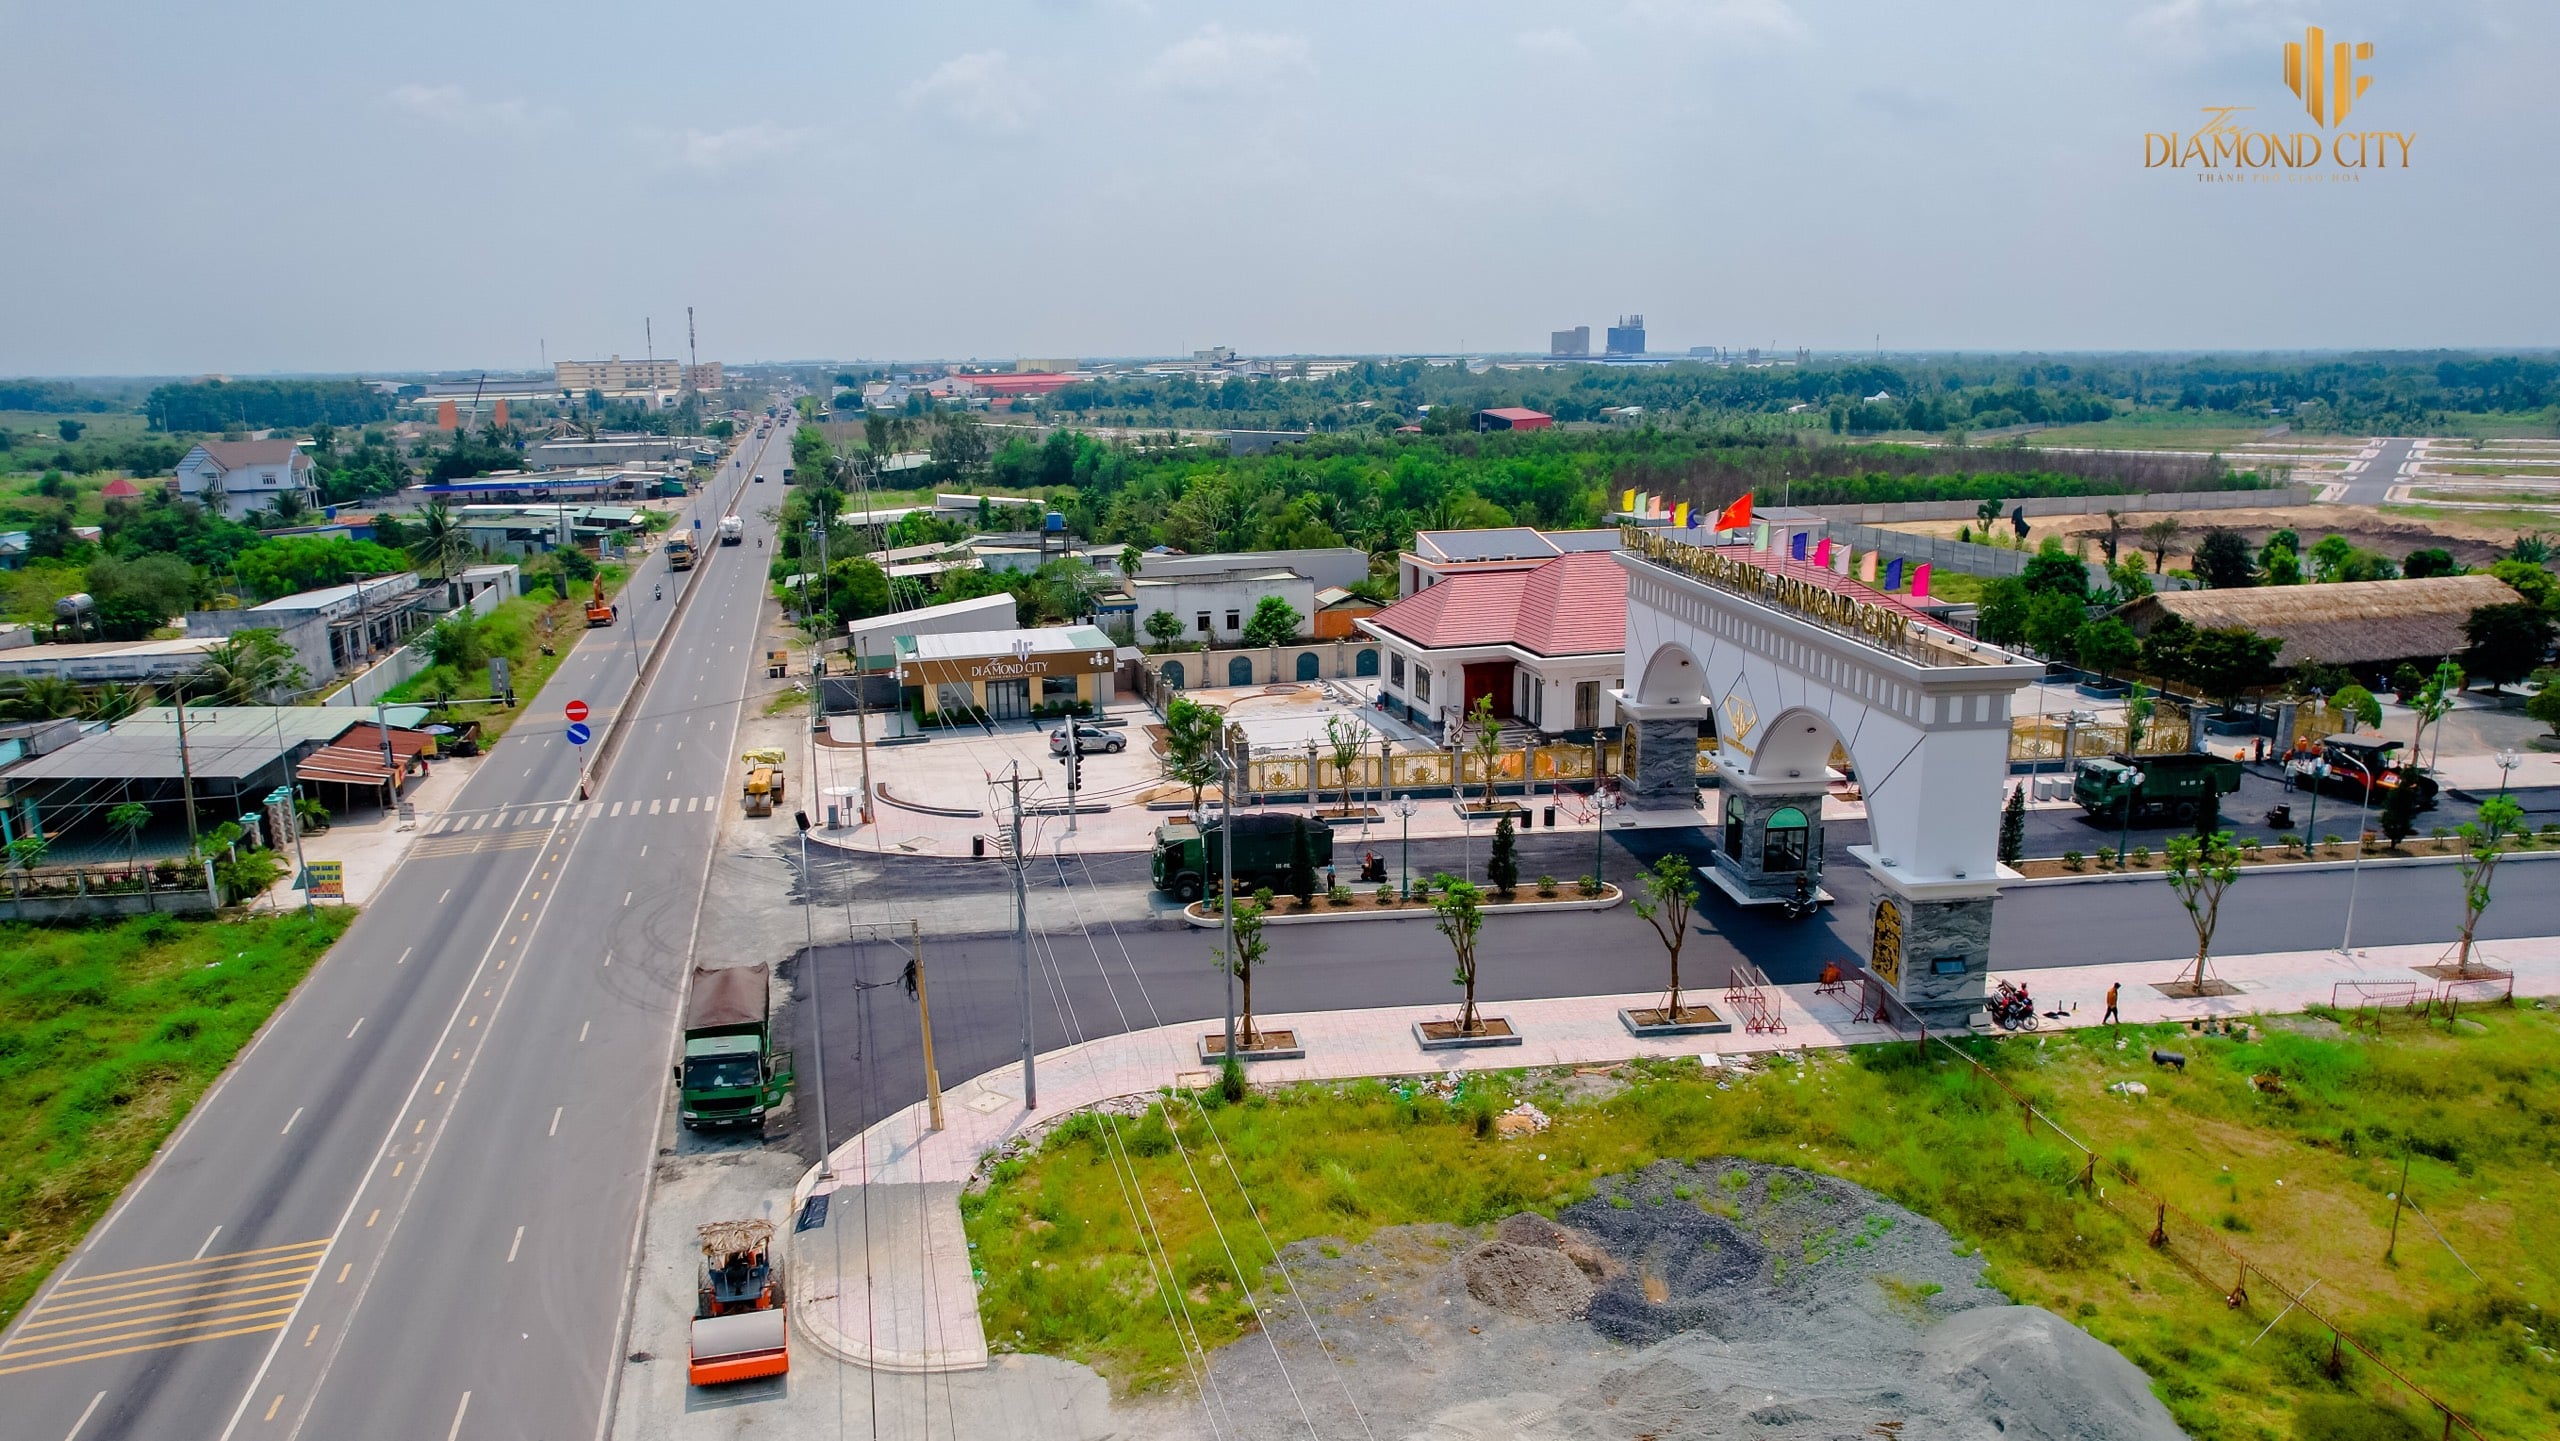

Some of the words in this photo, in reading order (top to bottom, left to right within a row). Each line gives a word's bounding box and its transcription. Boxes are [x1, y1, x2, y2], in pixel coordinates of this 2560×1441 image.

[1776, 573, 1858, 627] DIAMOND
[1861, 602, 1909, 646] CITY
[971, 663, 1024, 677] DIAMOND
[1024, 661, 1049, 673] CITY
